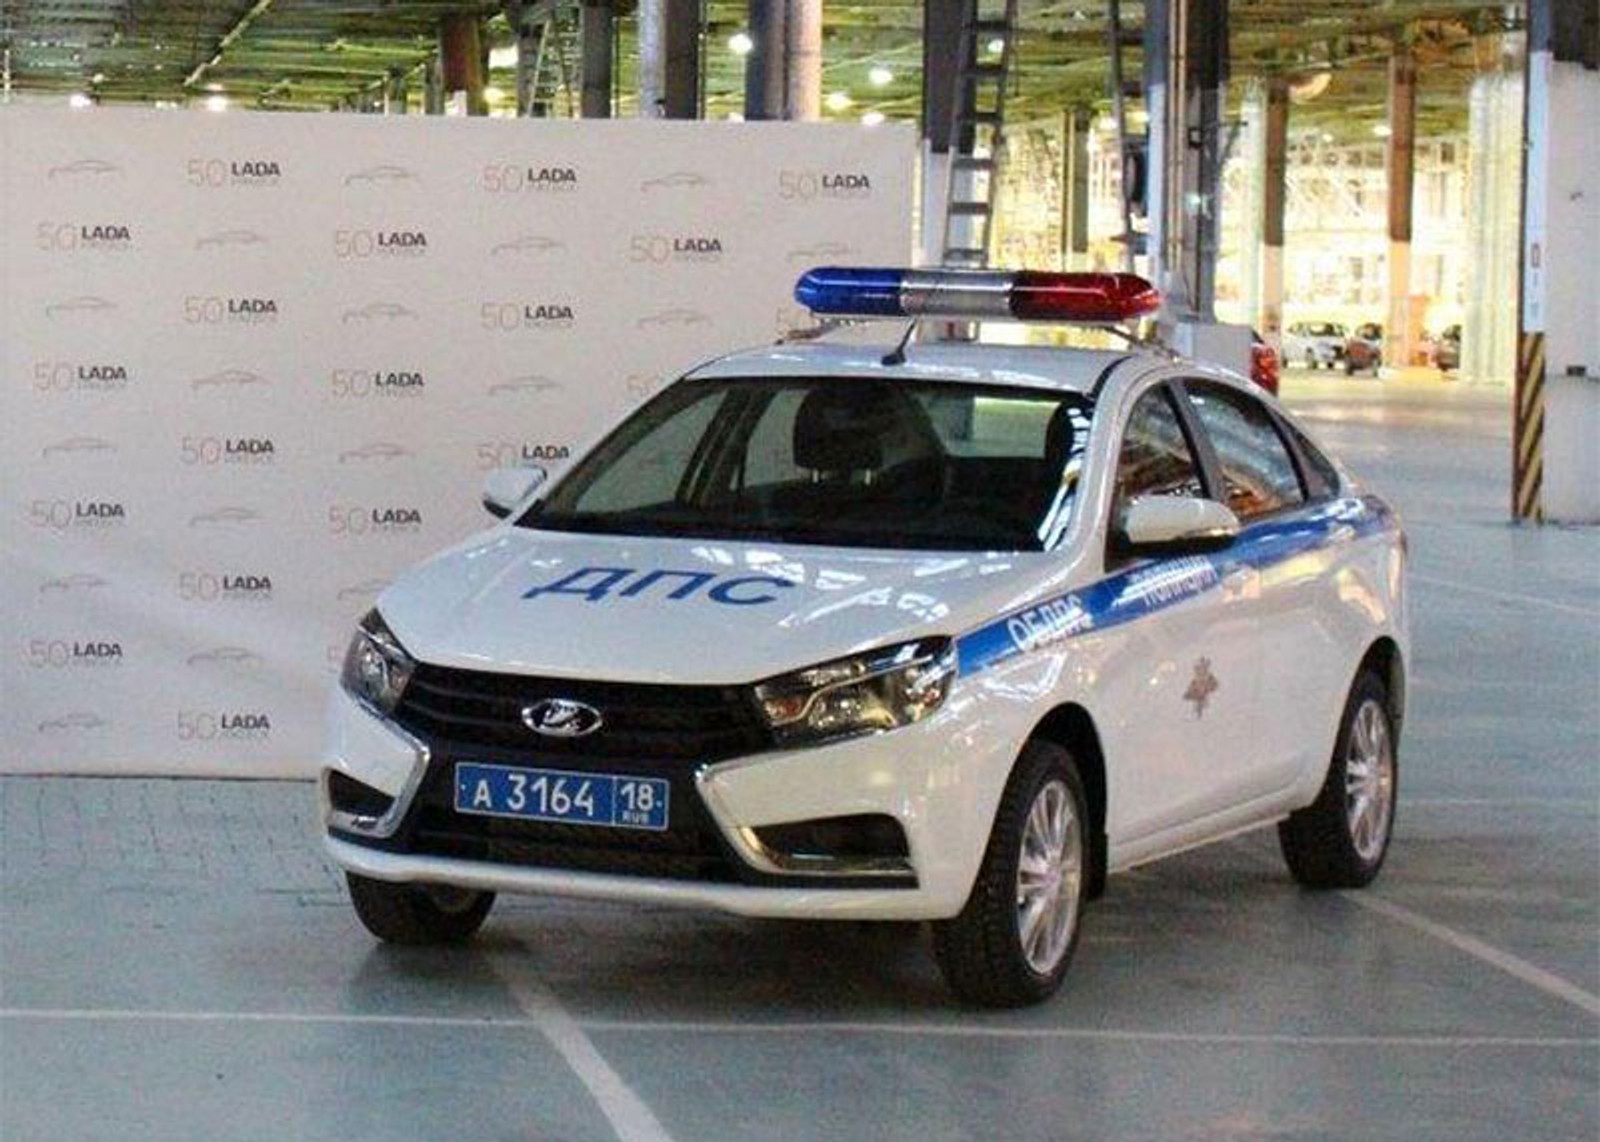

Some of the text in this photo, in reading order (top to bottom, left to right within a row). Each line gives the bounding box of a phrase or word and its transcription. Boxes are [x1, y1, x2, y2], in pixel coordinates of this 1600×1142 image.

[231, 161, 281, 177] LADA
[527, 167, 577, 184] LADA
[822, 174, 870, 189] LADA
[81, 225, 131, 241] LADA
[378, 232, 427, 247] LADA
[673, 238, 723, 254] LADA
[228, 298, 278, 314] LADA
[524, 305, 574, 320] LADA
[78, 366, 127, 382] LADA
[375, 372, 425, 388] LADA
[225, 439, 275, 455] LADA
[521, 445, 570, 461] LADA
[76, 502, 125, 519] LADA
[372, 508, 422, 524] LADA
[223, 575, 272, 591] LADA
[521, 566, 796, 606] ДПС
[73, 642, 123, 658] LADA
[221, 714, 270, 730] LADA
[507, 773, 594, 816] 3164
[620, 782, 654, 811] 18
